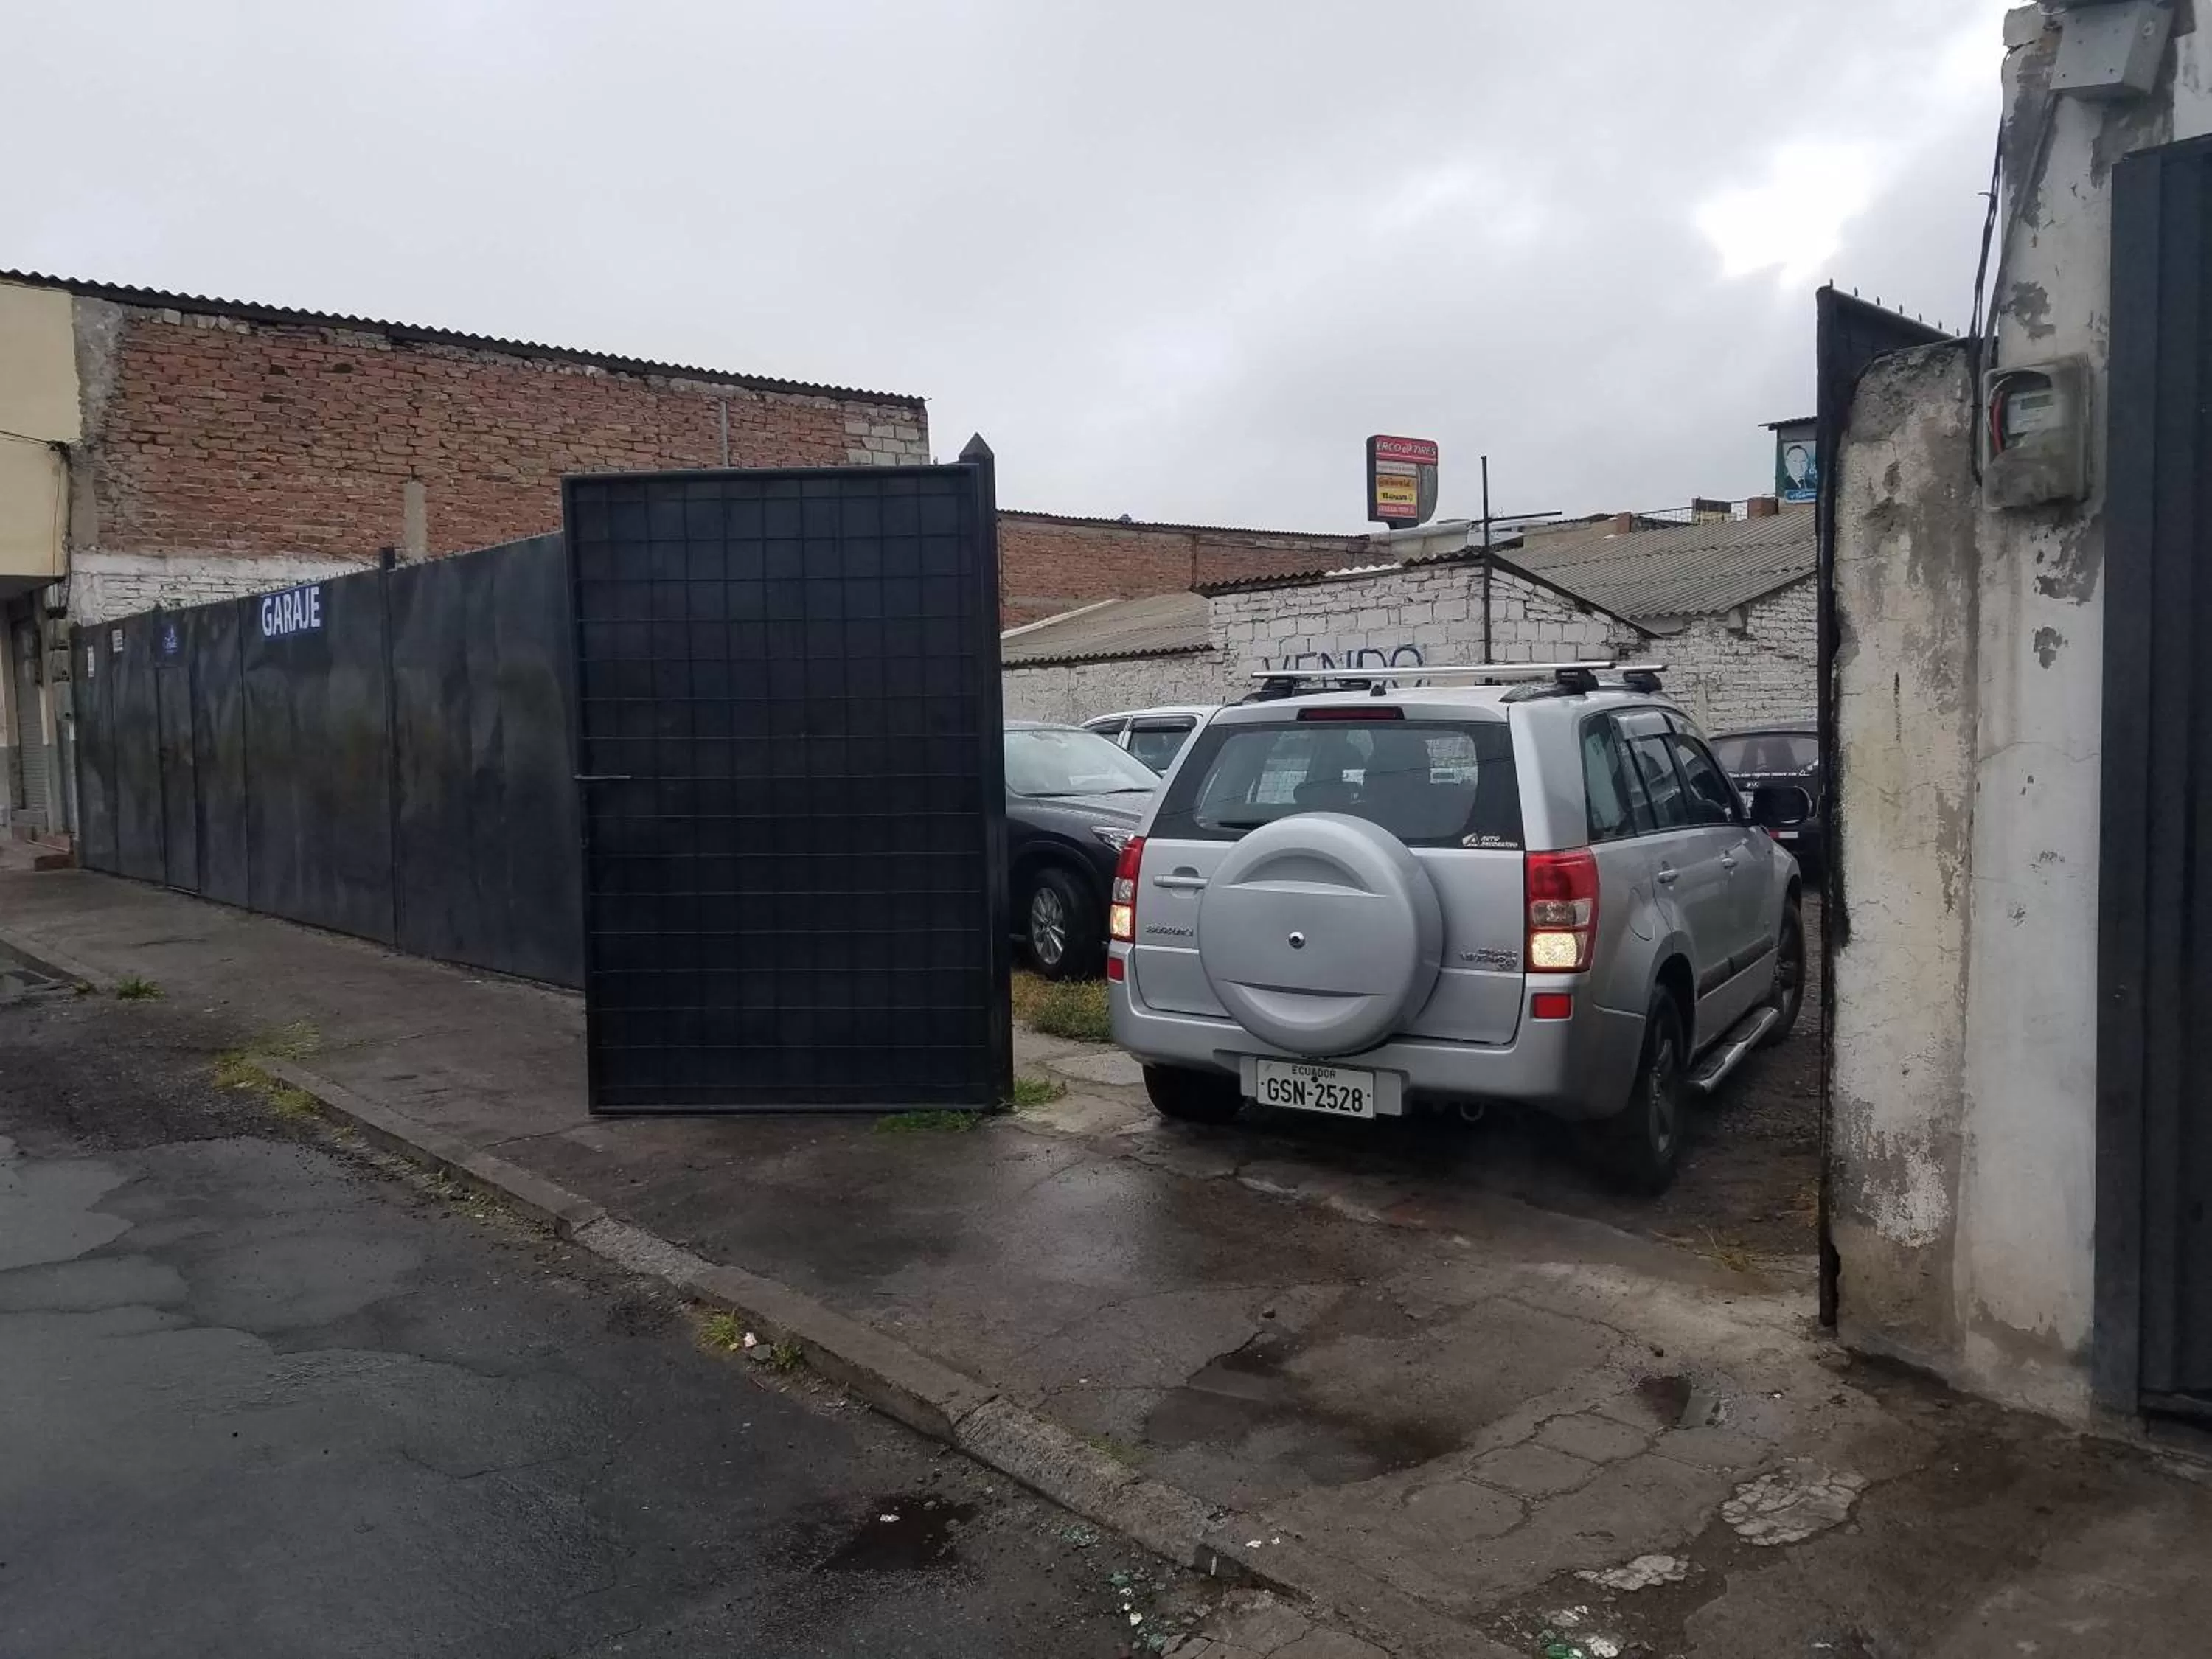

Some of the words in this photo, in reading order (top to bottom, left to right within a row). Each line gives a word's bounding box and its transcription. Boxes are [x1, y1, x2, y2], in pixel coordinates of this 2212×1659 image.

[1413, 445, 1437, 456] TIRES
[262, 586, 321, 636] GARAJE
[1292, 1065, 1336, 1079] ECUADOR
[1267, 1077, 1363, 1113] GSN-2528
